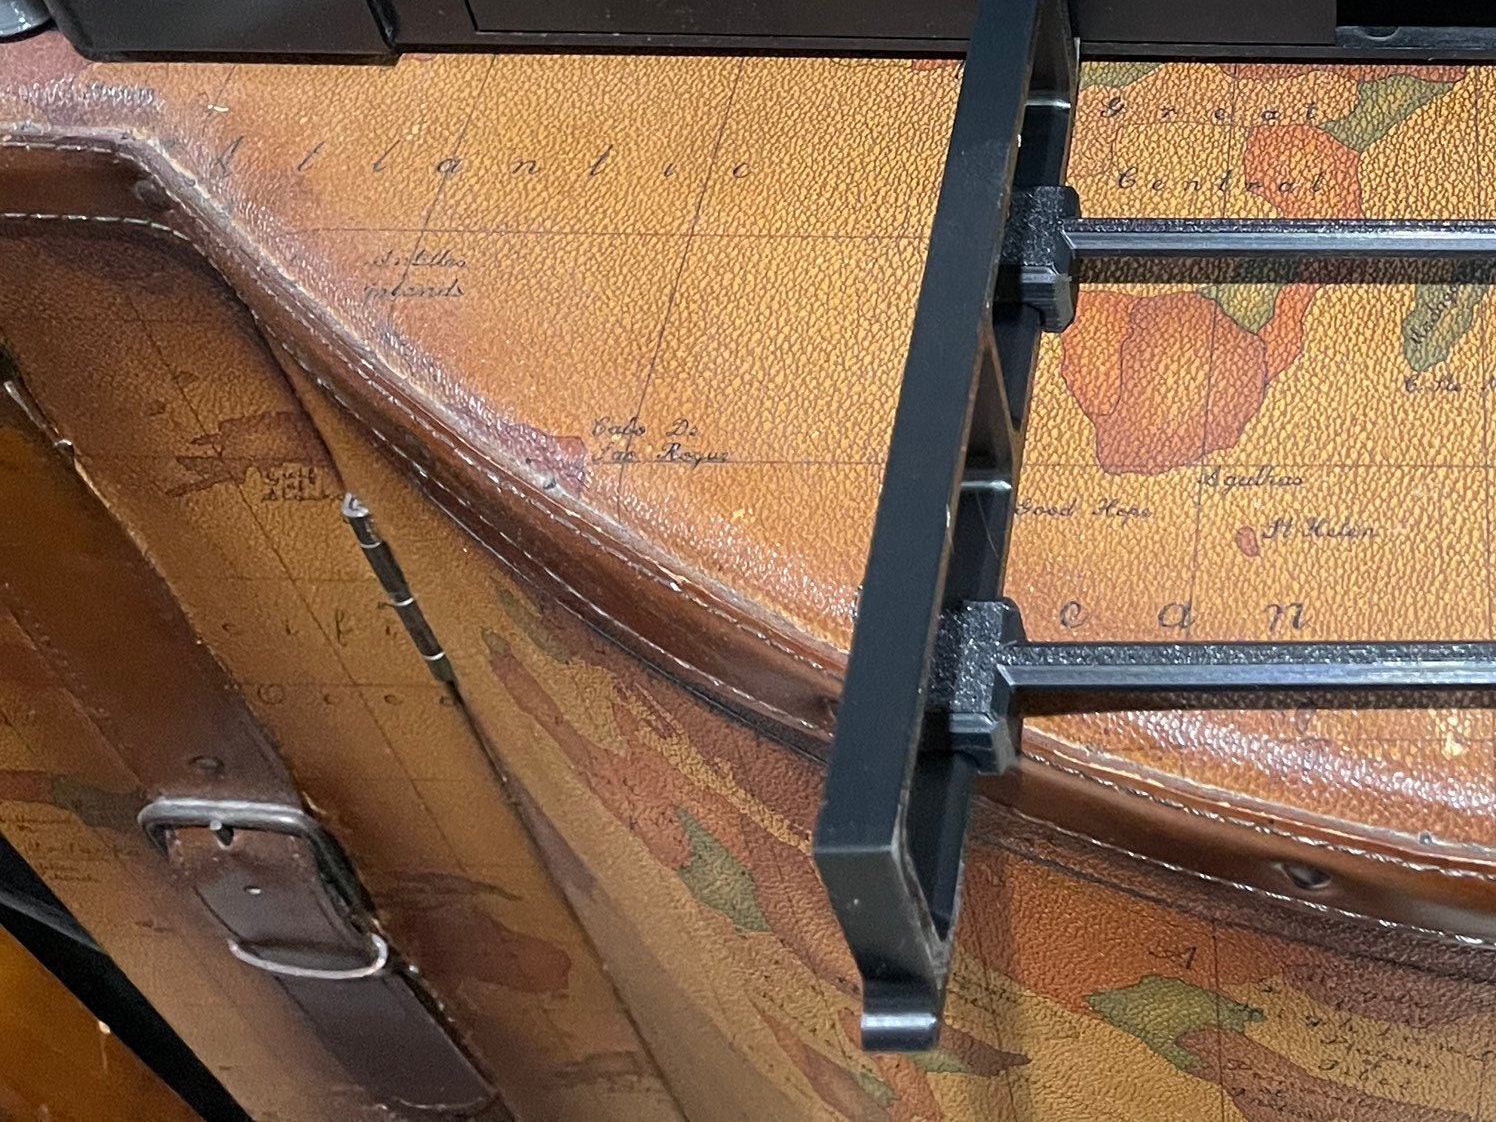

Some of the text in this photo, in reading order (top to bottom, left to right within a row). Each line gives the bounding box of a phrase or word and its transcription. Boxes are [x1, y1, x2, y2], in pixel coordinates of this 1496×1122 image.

[1100, 95, 1320, 122] Great
[1117, 166, 1325, 194] Central
[1092, 498, 1152, 526] Hope
